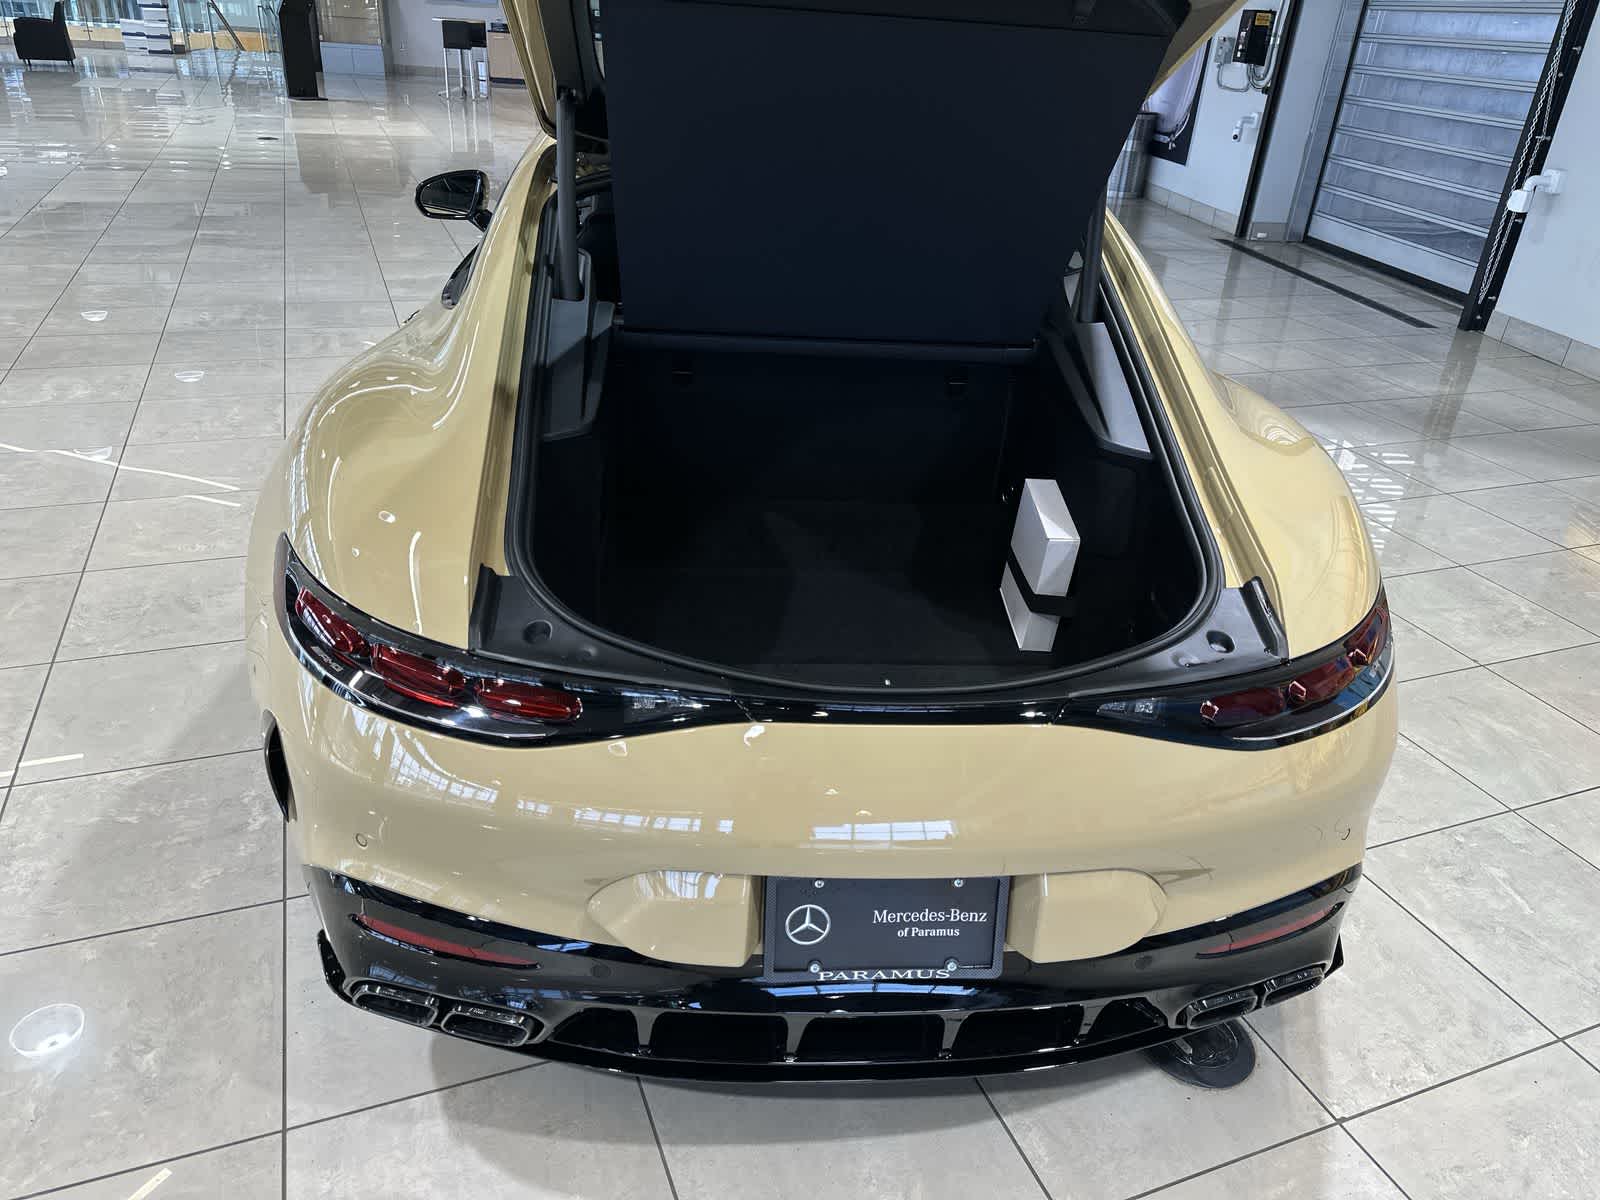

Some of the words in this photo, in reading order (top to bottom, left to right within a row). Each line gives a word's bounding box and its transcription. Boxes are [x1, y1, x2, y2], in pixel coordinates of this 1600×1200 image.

[872, 908, 988, 924] Mercedes-Benz
[897, 927, 910, 938] of
[911, 926, 960, 937] Paramus
[818, 969, 951, 981] PARAMUS
